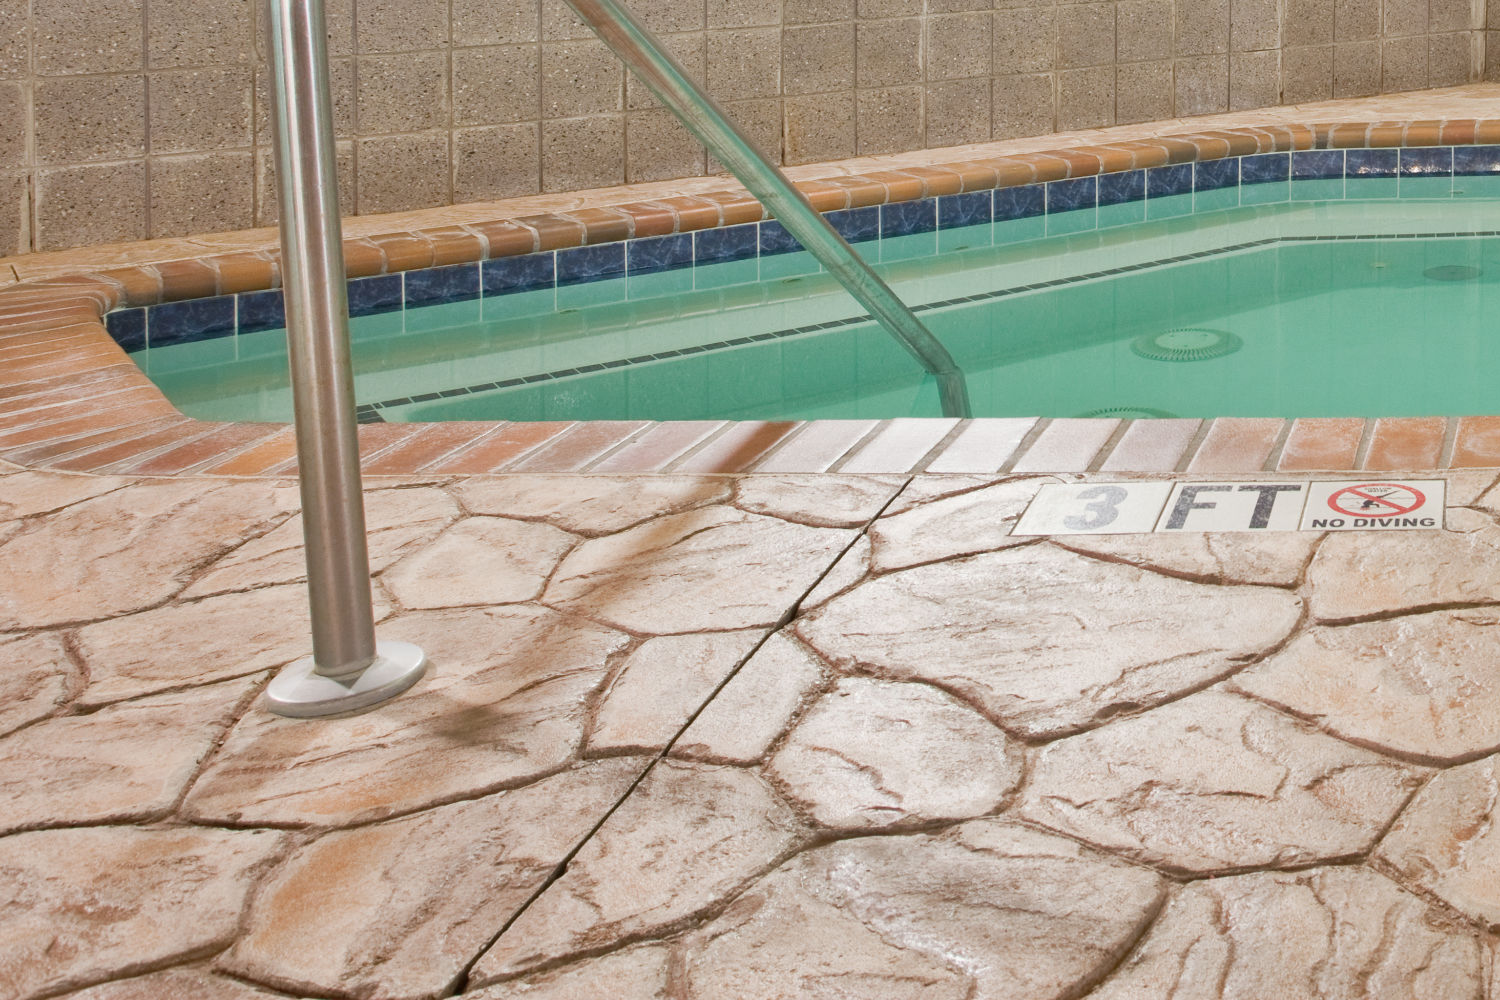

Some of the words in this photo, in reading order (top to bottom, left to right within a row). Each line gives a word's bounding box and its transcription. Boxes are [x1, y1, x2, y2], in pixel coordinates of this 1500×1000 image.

[1062, 485, 1129, 532] 3
[1164, 484, 1302, 530] FT
[1312, 518, 1346, 528] NO
[1353, 517, 1436, 528] DIVING
